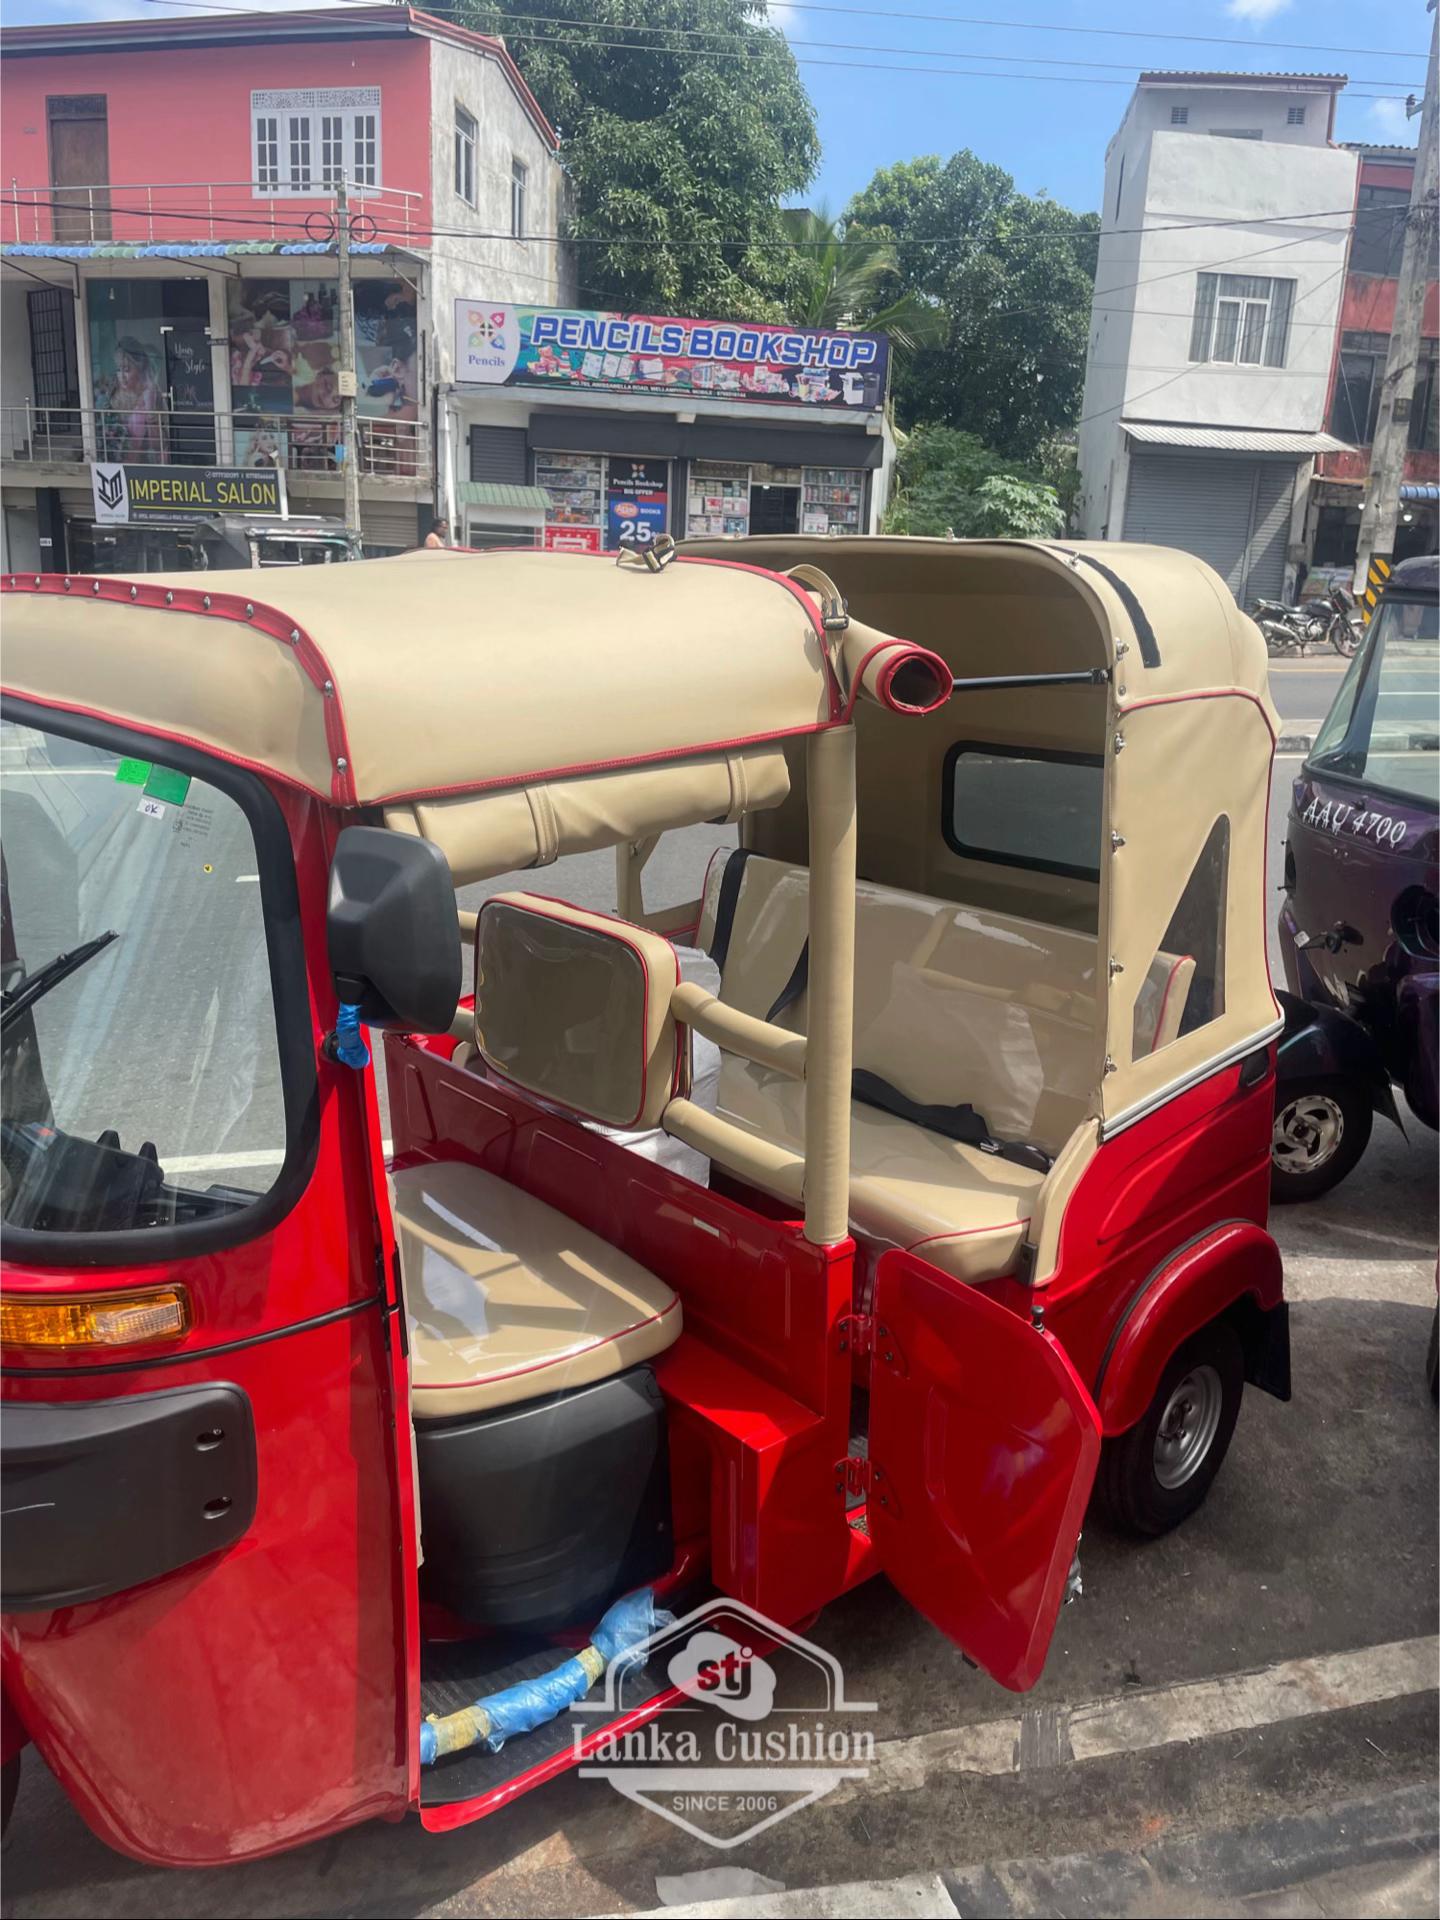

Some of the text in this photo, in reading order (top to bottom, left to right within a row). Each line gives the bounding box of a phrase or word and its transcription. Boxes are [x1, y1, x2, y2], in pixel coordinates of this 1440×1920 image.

[468, 354, 505, 368] Pencils
[531, 315, 877, 369] PENCILS BOOKSHOP
[129, 479, 276, 505] IMPERIAL SALON
[1303, 796, 1407, 848] AAU 4700
